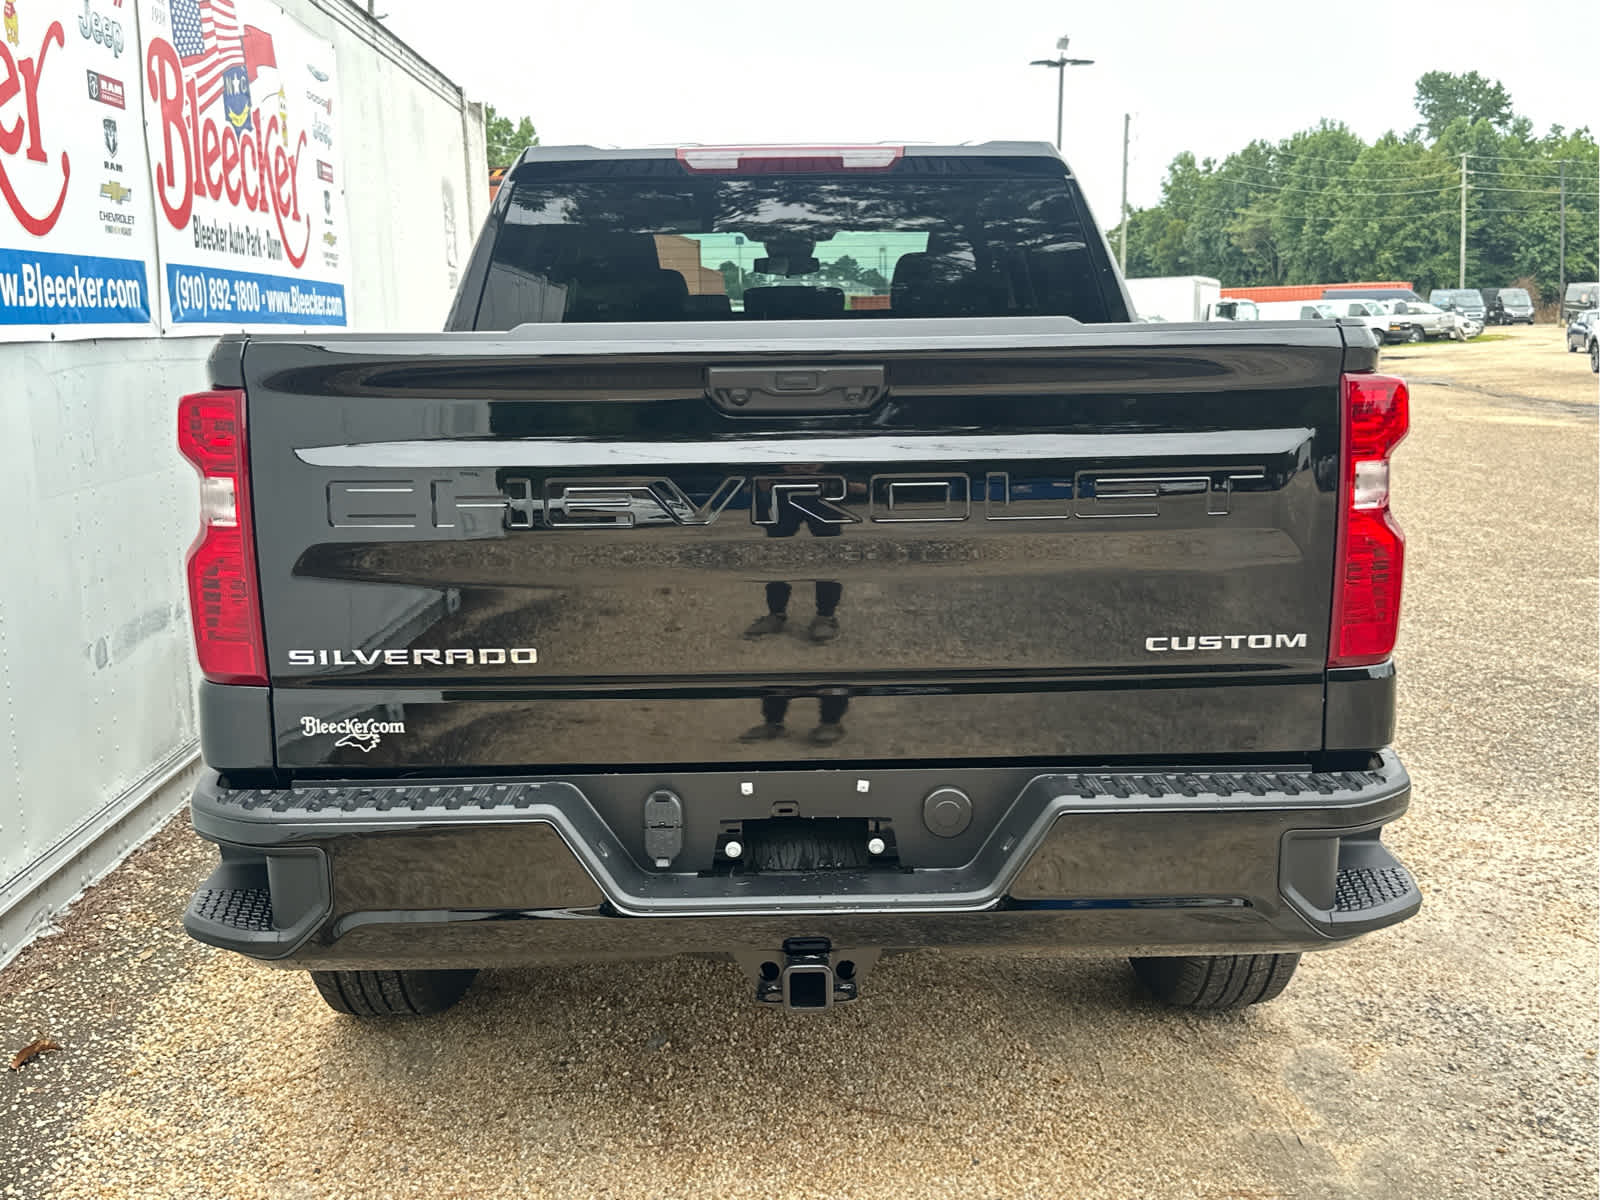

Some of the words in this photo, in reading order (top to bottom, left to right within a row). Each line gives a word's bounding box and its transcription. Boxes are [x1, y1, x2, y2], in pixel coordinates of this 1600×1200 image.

[78, 0, 124, 58] Jeep
[100, 79, 123, 97] RAM
[103, 160, 124, 173] RAM
[98, 209, 136, 225] CHEVROLET
[193, 214, 227, 252] Bleecker
[229, 221, 245, 255] Auto
[246, 225, 263, 258] Park
[175, 270, 208, 318] (910)
[208, 277, 261, 312] 892-1800
[266, 286, 342, 316] www.Bleecker.com
[325, 465, 1267, 529] CHEVROLET
[1145, 633, 1307, 651] CUSTOM
[288, 648, 538, 665] SILVERADO
